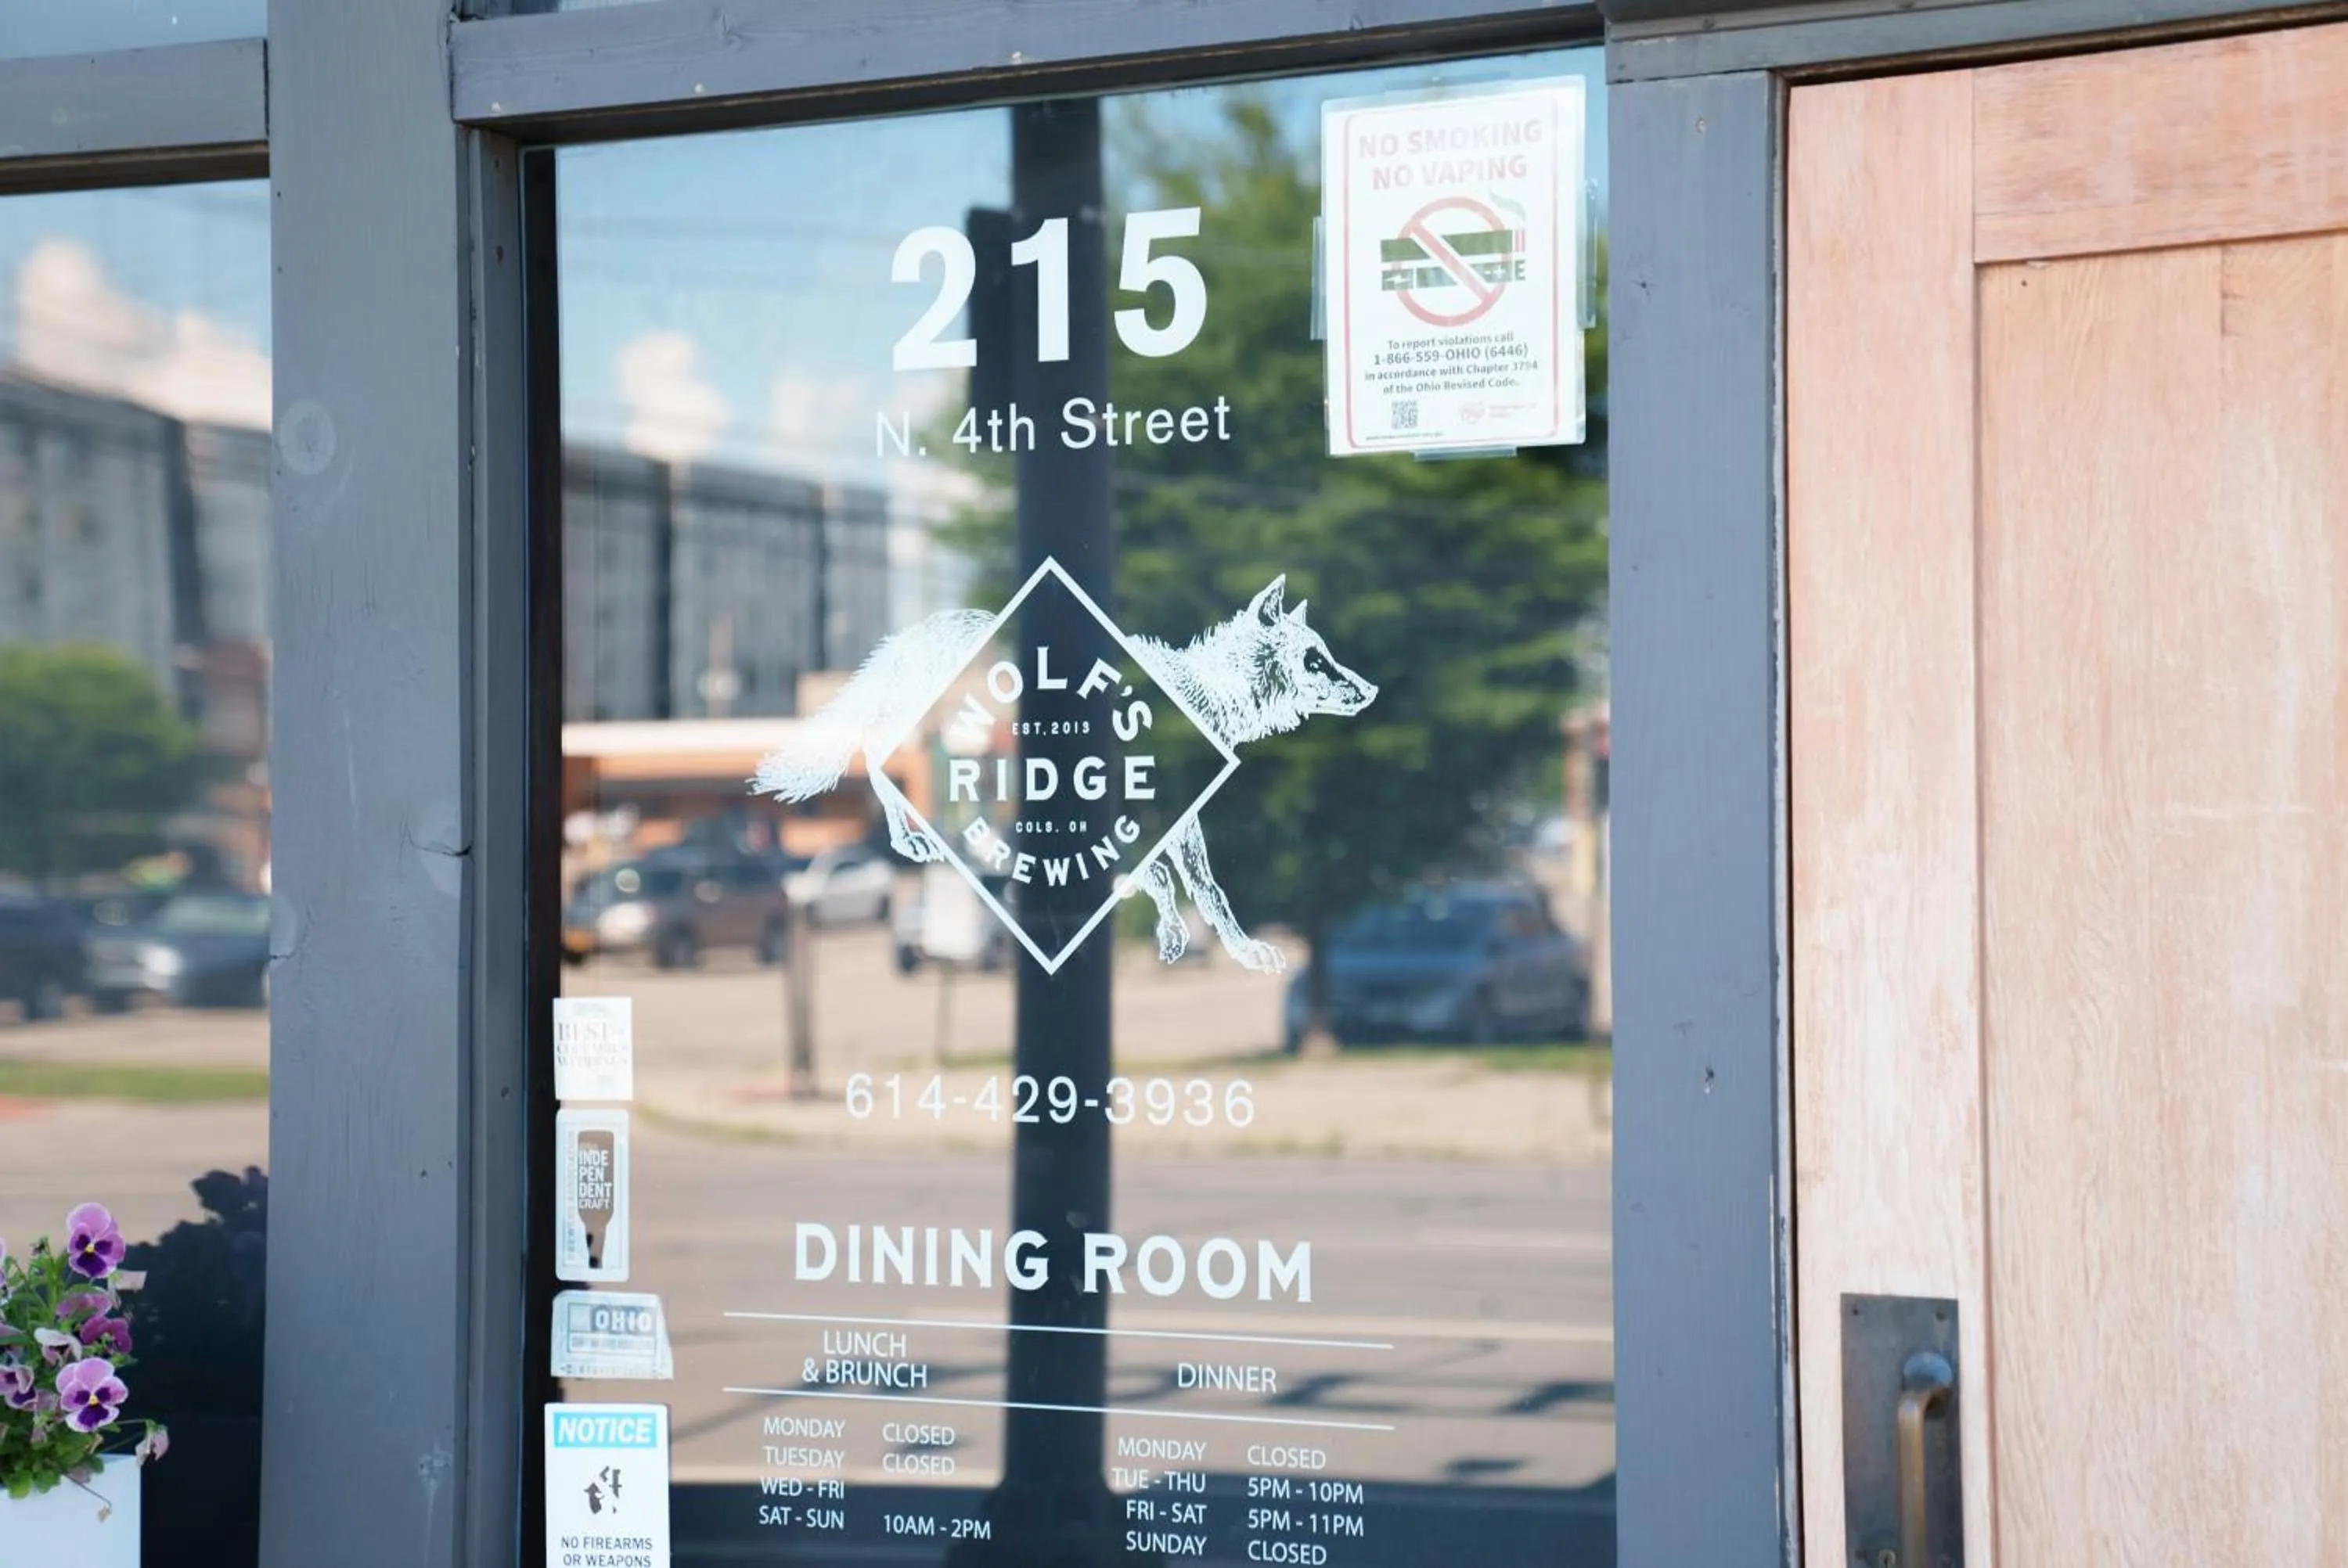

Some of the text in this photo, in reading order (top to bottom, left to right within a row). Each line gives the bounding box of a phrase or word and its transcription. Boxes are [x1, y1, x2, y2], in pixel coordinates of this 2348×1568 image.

[1359, 119, 1543, 158] NO SMOKING
[1373, 154, 1529, 190] NO VAPING
[891, 207, 1207, 372] 215
[1388, 331, 1514, 352] To report violations call
[1374, 343, 1529, 366] 1-866-559-OHIO (6446)
[1365, 369, 1375, 381] in
[1377, 366, 1437, 380] accordance
[1439, 363, 1464, 376] with
[1466, 360, 1509, 376] Chapter
[1383, 382, 1394, 394] of
[1395, 382, 1413, 394] the
[1415, 379, 1441, 392] Ohio
[1443, 377, 1486, 390] Revised
[876, 396, 1231, 458] N. 4th Street
[947, 646, 1153, 743] WOLF'S
[949, 755, 1155, 802] RIDGE
[1069, 821, 1087, 833] OH
[962, 815, 1140, 887] BREWING
[846, 1072, 1255, 1127] 614-429-3936
[578, 1149, 609, 1166] INDE
[578, 1166, 605, 1182] PEN
[578, 1182, 612, 1198] DENT
[578, 1198, 610, 1210] CRAFT
[794, 1221, 1313, 1303] DINING ROOM
[595, 1309, 652, 1332] OHIO
[823, 1330, 907, 1358] LUNCH
[802, 1359, 927, 1388] & BRUNCH
[1177, 1361, 1277, 1394] DINNER
[558, 1417, 653, 1444] NOTICE
[763, 1416, 846, 1439] MONDAY
[882, 1422, 956, 1446] CLOSED
[763, 1445, 845, 1469] TUESDAY
[1118, 1437, 1207, 1461] MONDAY
[1247, 1445, 1326, 1469] CLOSED
[882, 1452, 956, 1476] CLOSED
[759, 1476, 802, 1498] WED
[818, 1480, 845, 1500] FRI
[1111, 1466, 1149, 1490] TUE
[1165, 1471, 1207, 1493] THU
[1248, 1477, 1291, 1500] 5PM
[1309, 1482, 1364, 1505] 10PM
[758, 1505, 792, 1526] SAT
[806, 1509, 845, 1530] SUN
[1126, 1499, 1154, 1521] FRI
[1172, 1502, 1207, 1525] SAT
[1248, 1509, 1291, 1531] 5PM
[1309, 1513, 1365, 1537] 11PM
[883, 1514, 935, 1537] 10AM
[951, 1519, 992, 1541] 2PM
[560, 1536, 653, 1550] NO FIREARMS
[1125, 1530, 1207, 1556] SUNDAY
[1248, 1540, 1327, 1566] CLOSED
[562, 1553, 653, 1567] OR WEAPONS
